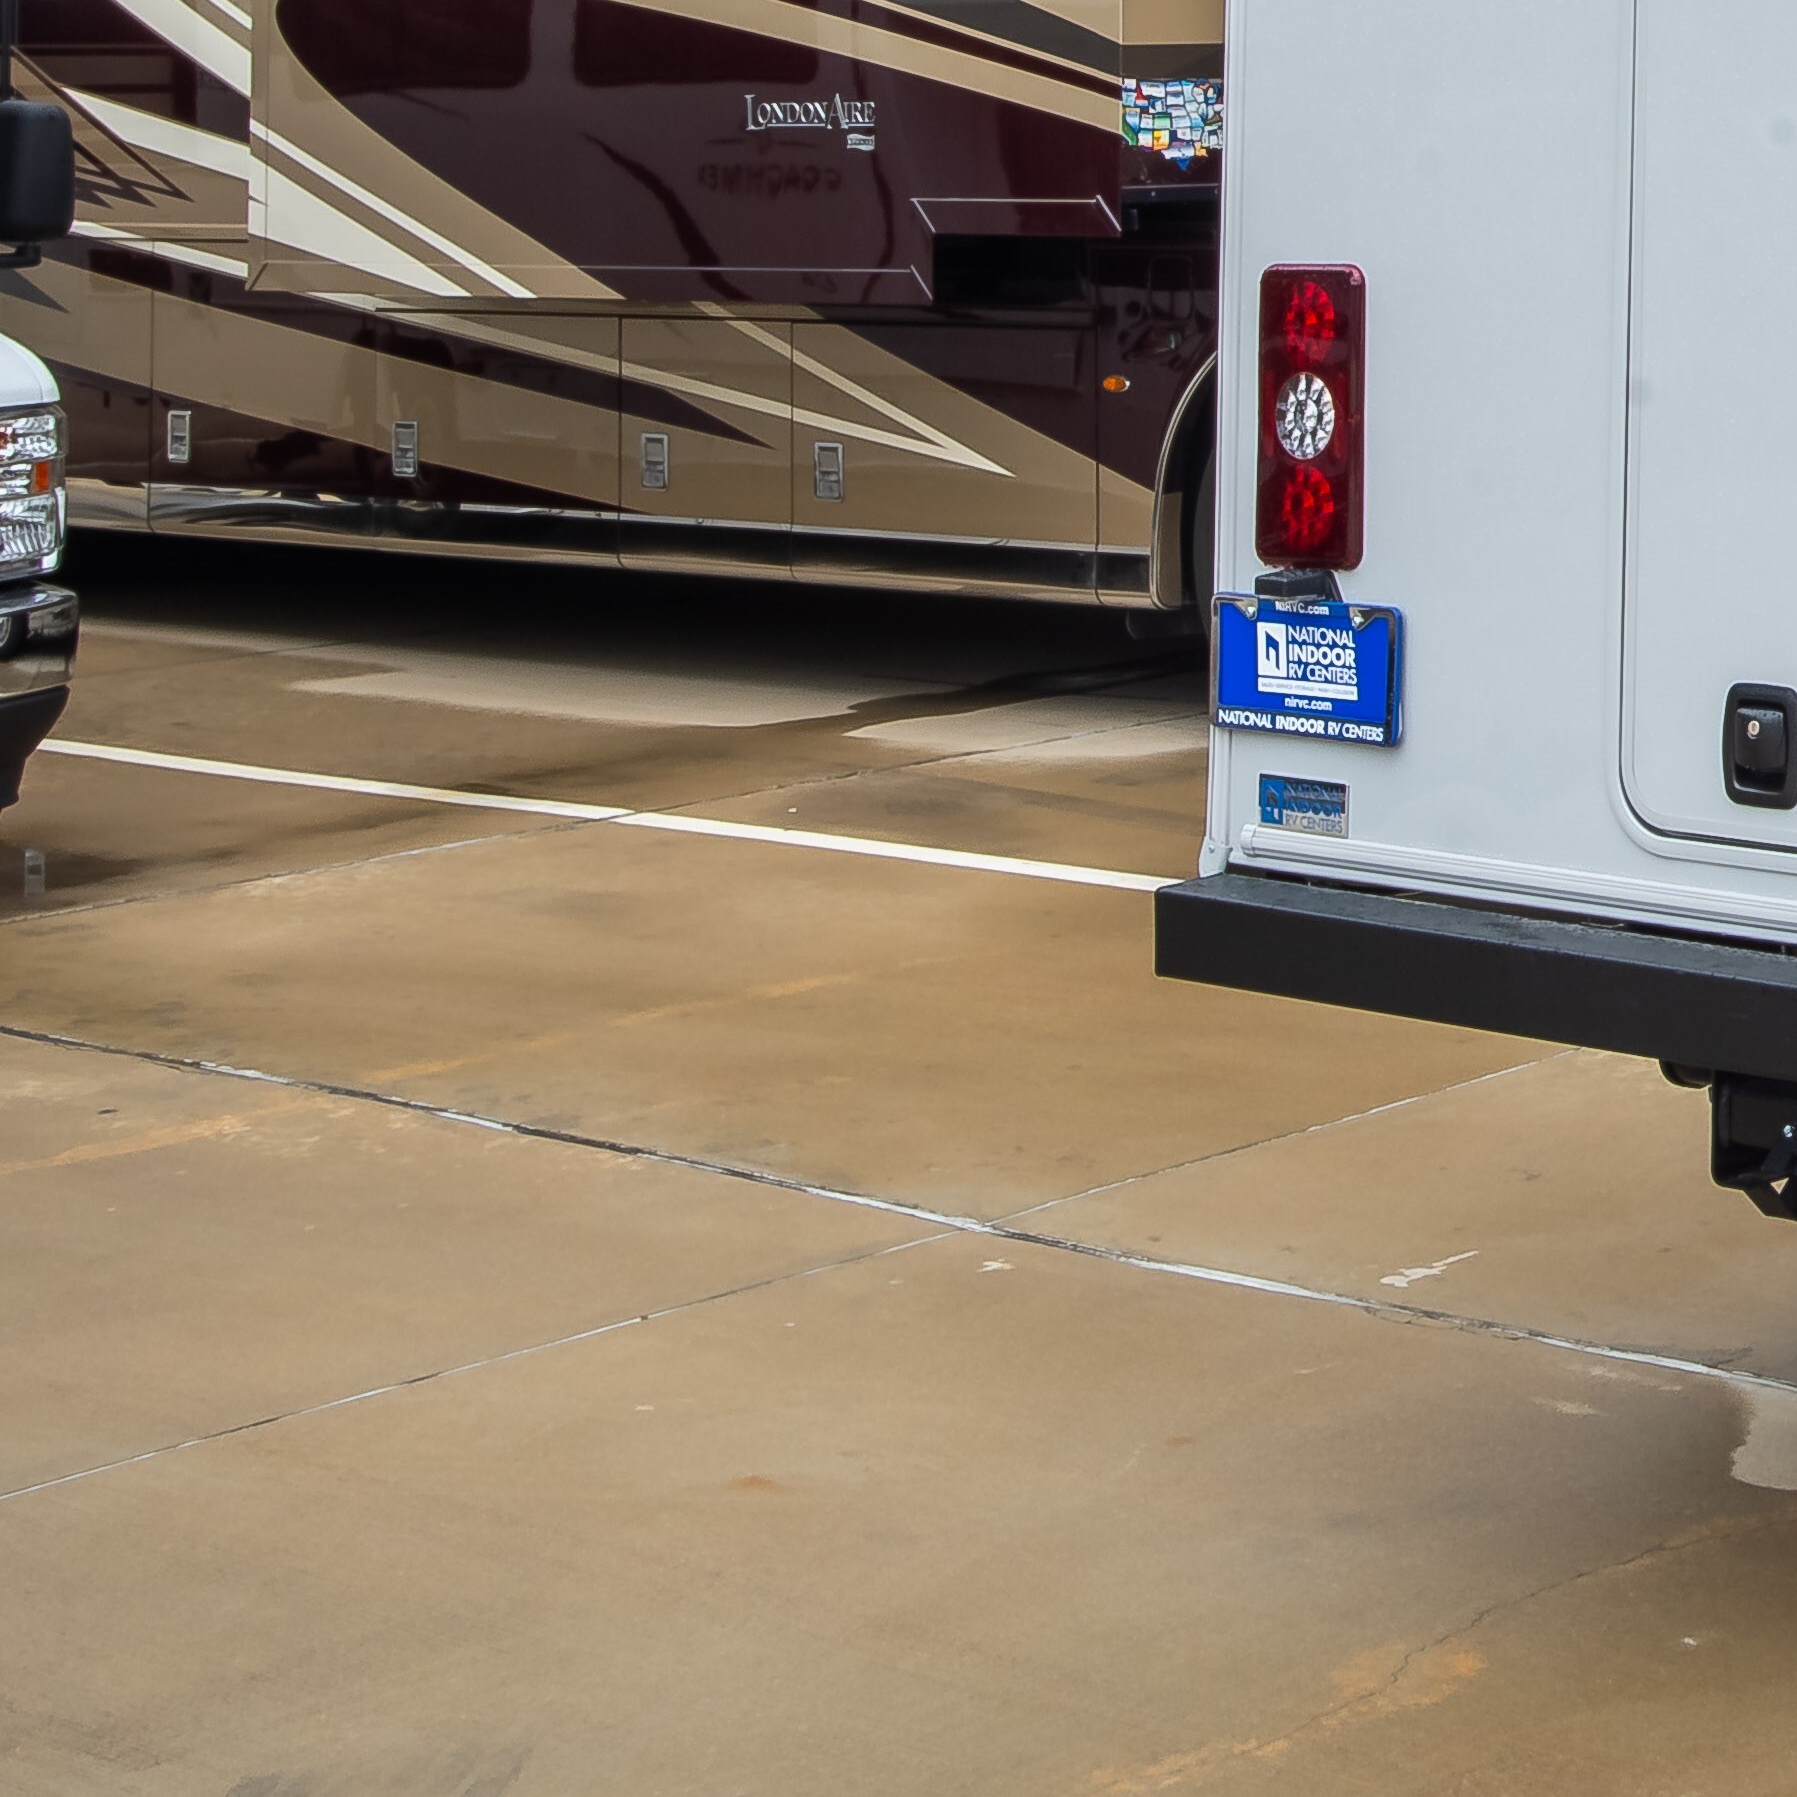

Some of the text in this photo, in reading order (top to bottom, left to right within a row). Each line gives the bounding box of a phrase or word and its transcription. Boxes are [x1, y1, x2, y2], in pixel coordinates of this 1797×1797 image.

[1287, 624, 1356, 648] NATIONAL
[1288, 643, 1357, 668] INDOOR
[1288, 663, 1358, 685] RV CENTERS
[1284, 696, 1333, 712] nirvc.com
[1218, 709, 1384, 742] NATIONAL INDOOR RV CENTERS
[1284, 782, 1345, 802] NATIONAL
[1284, 800, 1343, 820] INDOOR
[1285, 813, 1343, 835] RV CENTERS
